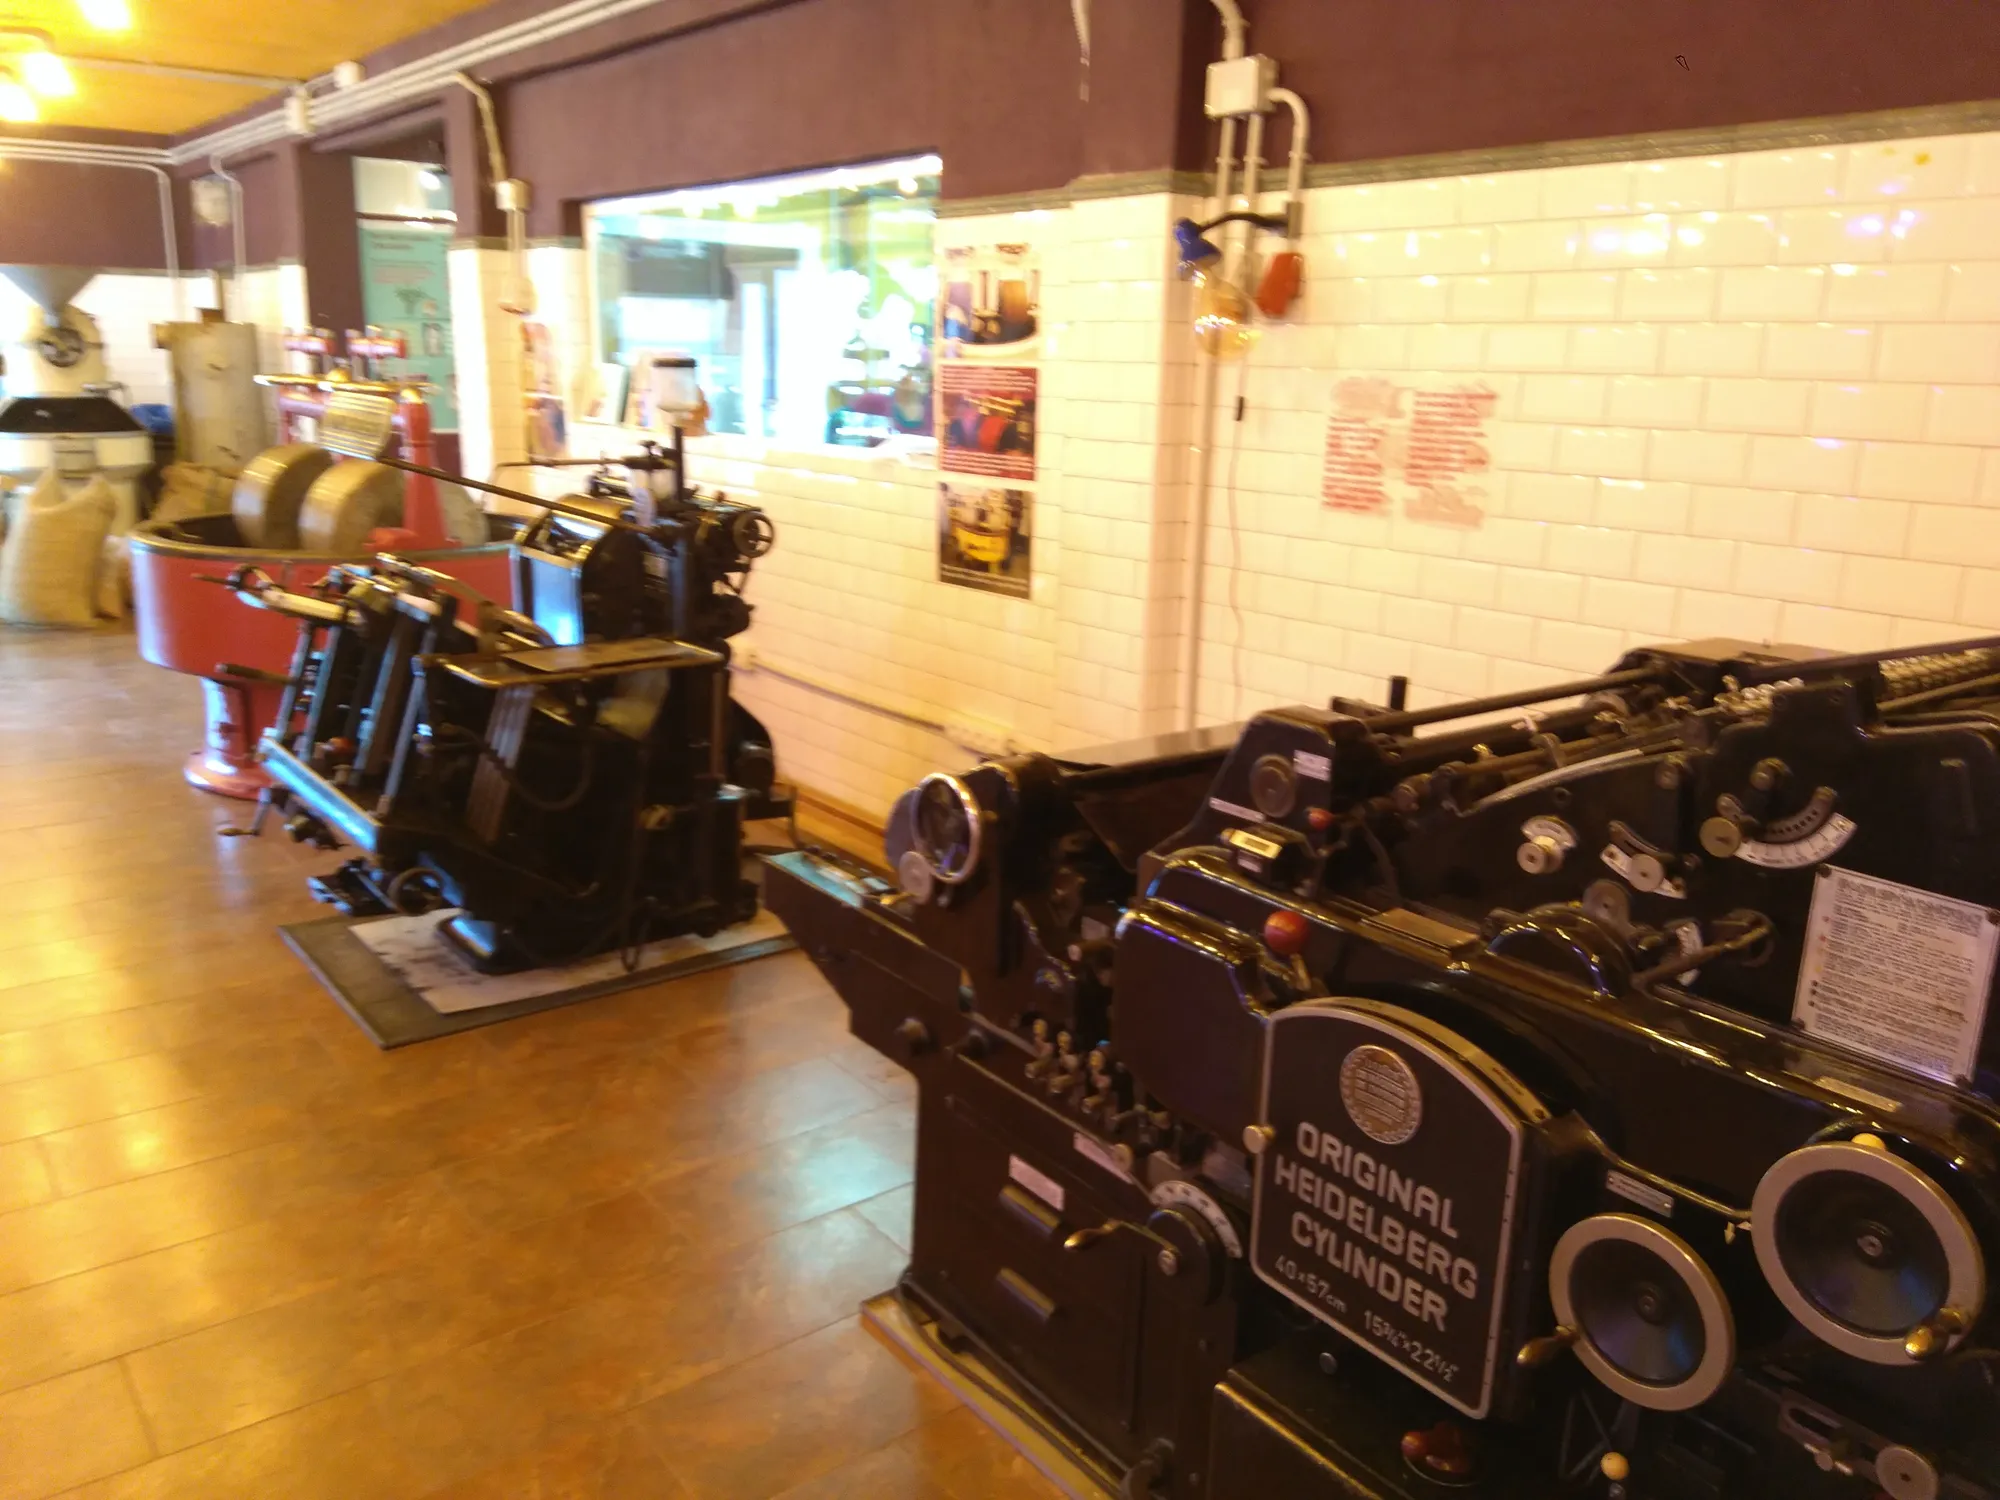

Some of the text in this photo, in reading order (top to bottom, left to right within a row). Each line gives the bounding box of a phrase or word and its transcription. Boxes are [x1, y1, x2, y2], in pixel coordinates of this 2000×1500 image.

[1274, 1154, 1478, 1300] HEIDELBERG
[1297, 1122, 1458, 1239] ORIGINAL
[1291, 1211, 1448, 1332] CYLINDER
